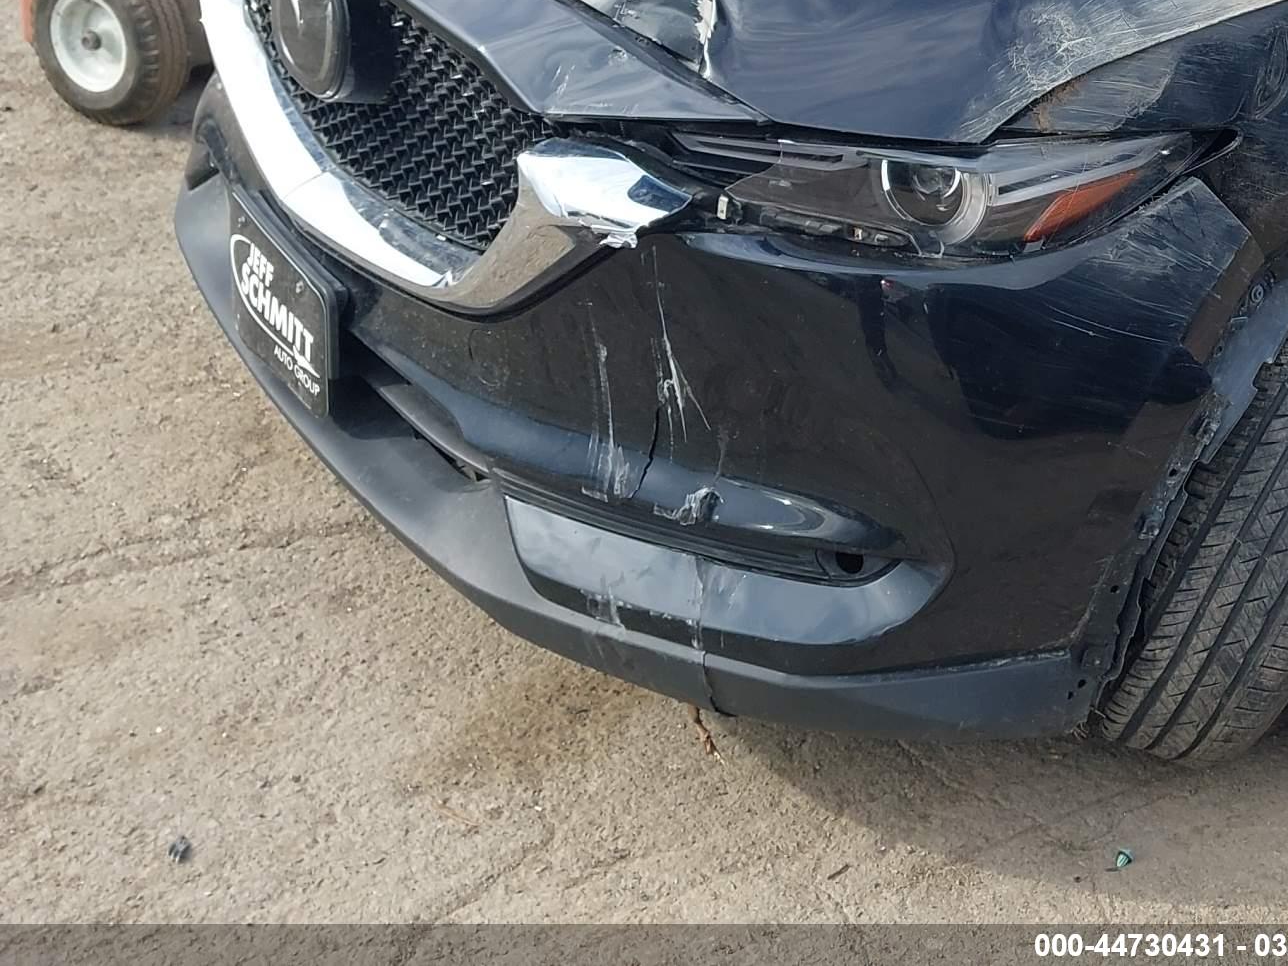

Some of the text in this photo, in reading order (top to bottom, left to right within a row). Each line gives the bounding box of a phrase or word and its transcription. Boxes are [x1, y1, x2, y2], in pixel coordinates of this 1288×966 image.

[247, 242, 275, 287] JEFF
[240, 261, 314, 362] SCHMITT
[274, 344, 320, 396] AUTO GROUP
